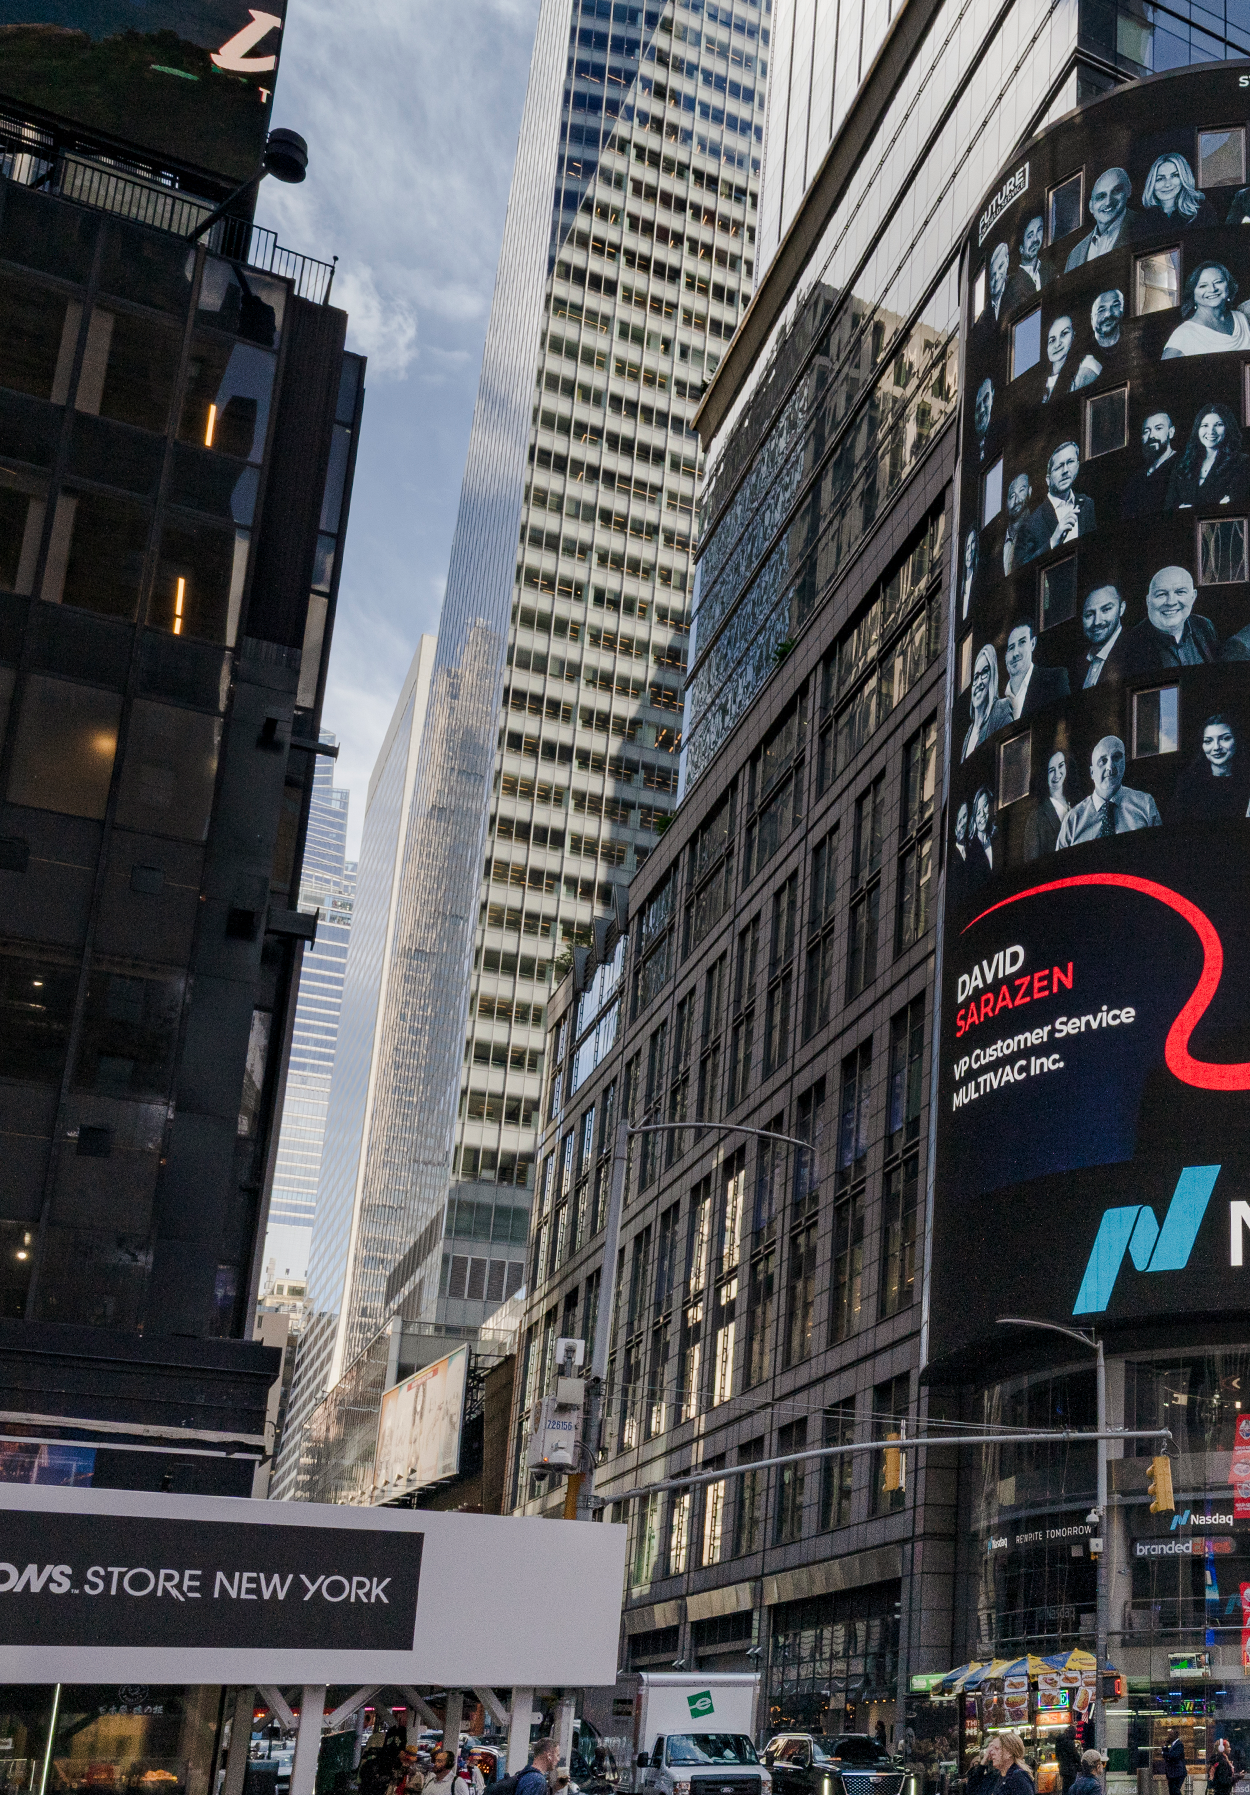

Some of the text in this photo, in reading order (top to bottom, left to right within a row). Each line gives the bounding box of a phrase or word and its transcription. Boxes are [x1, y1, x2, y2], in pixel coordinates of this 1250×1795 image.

[979, 166, 1024, 230] FUTURE
[956, 961, 1074, 1038] SARAZEN
[957, 944, 1025, 1004] DAVID
[953, 1004, 1136, 1081] VP Customer Service
[952, 1052, 1065, 1112] MULTIVAC Inc.
[547, 1419, 573, 1431] 726156
[1016, 1532, 1043, 1544] REWRITE
[1045, 1525, 1092, 1539] TOMORROW
[1190, 1514, 1233, 1526] Nasdaq
[84, 1565, 201, 1602] STORE
[213, 1571, 293, 1600] NEW
[300, 1574, 392, 1603] YORK
